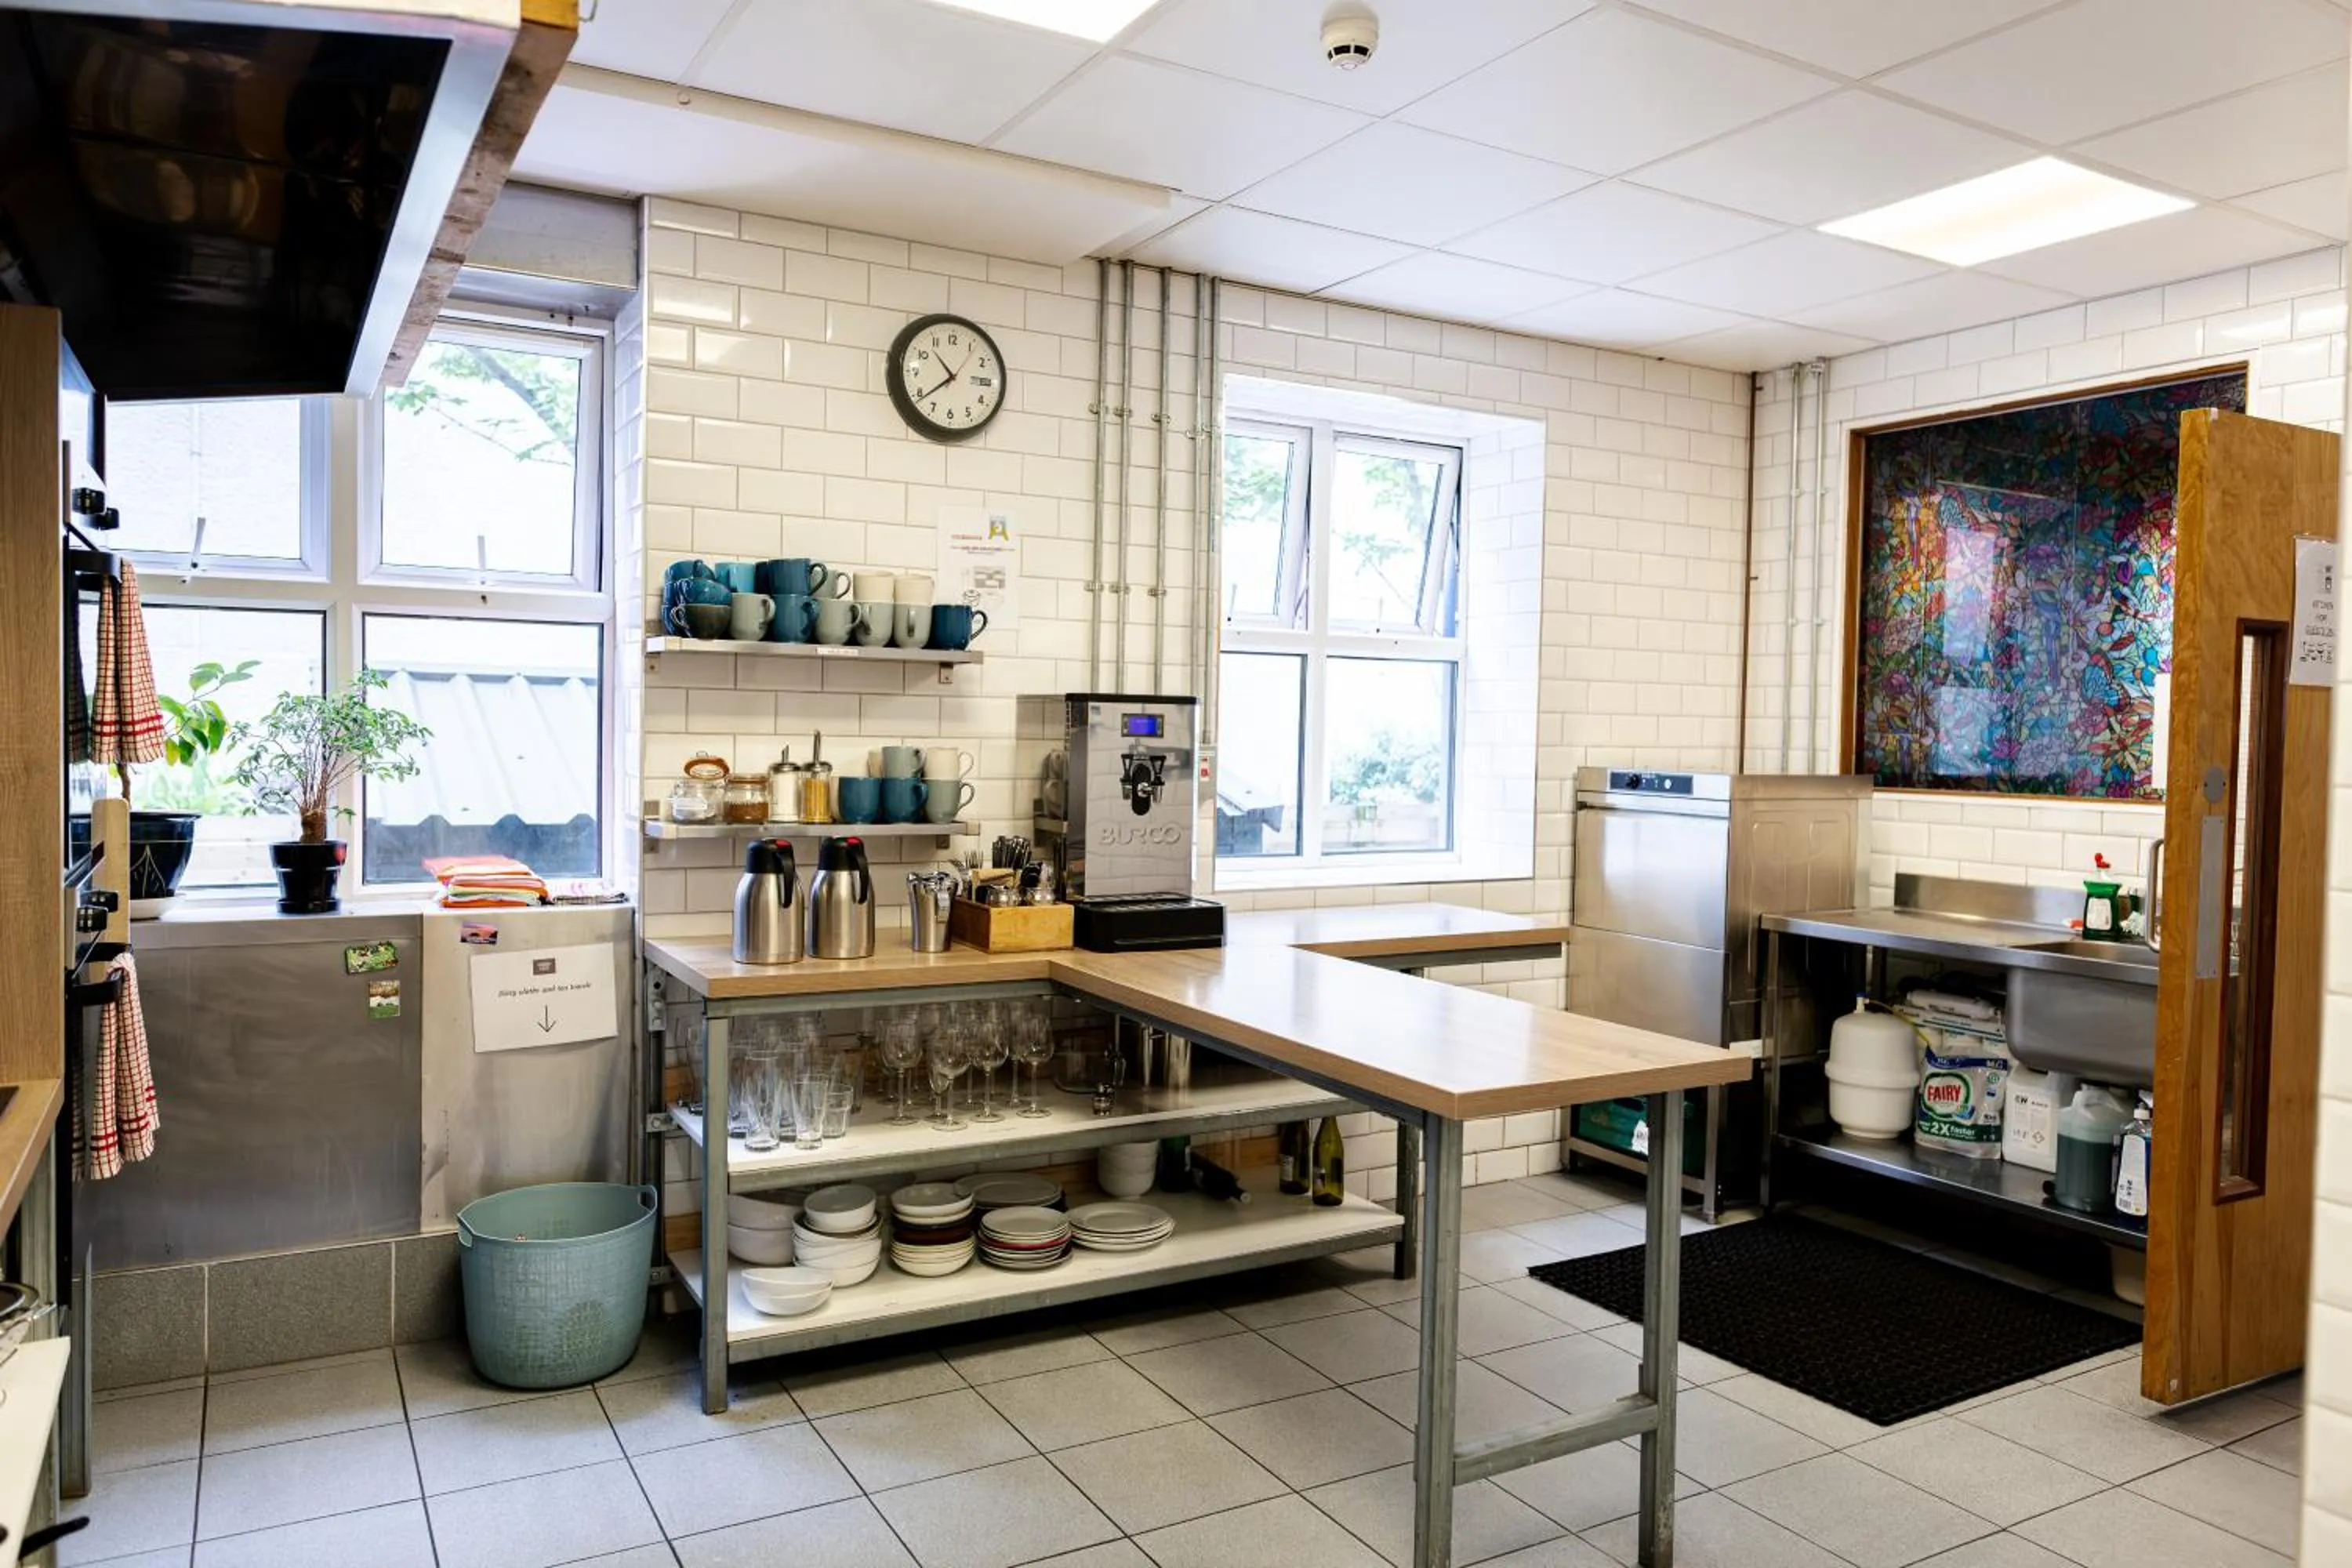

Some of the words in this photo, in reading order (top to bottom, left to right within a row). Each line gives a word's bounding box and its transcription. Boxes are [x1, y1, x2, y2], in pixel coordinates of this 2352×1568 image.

[932, 337, 939, 347] 11
[948, 334, 957, 346] 12
[918, 350, 929, 360] 10
[978, 357, 985, 368] 2
[978, 394, 984, 405] 4
[930, 401, 937, 412] 7
[946, 408, 954, 419] 6
[965, 407, 971, 418] 5
[1098, 827, 1181, 845] BURCO
[1927, 1084, 1961, 1102] FAIRY
[1930, 1121, 1950, 1135] 2X
[1950, 1125, 1975, 1135] faster
